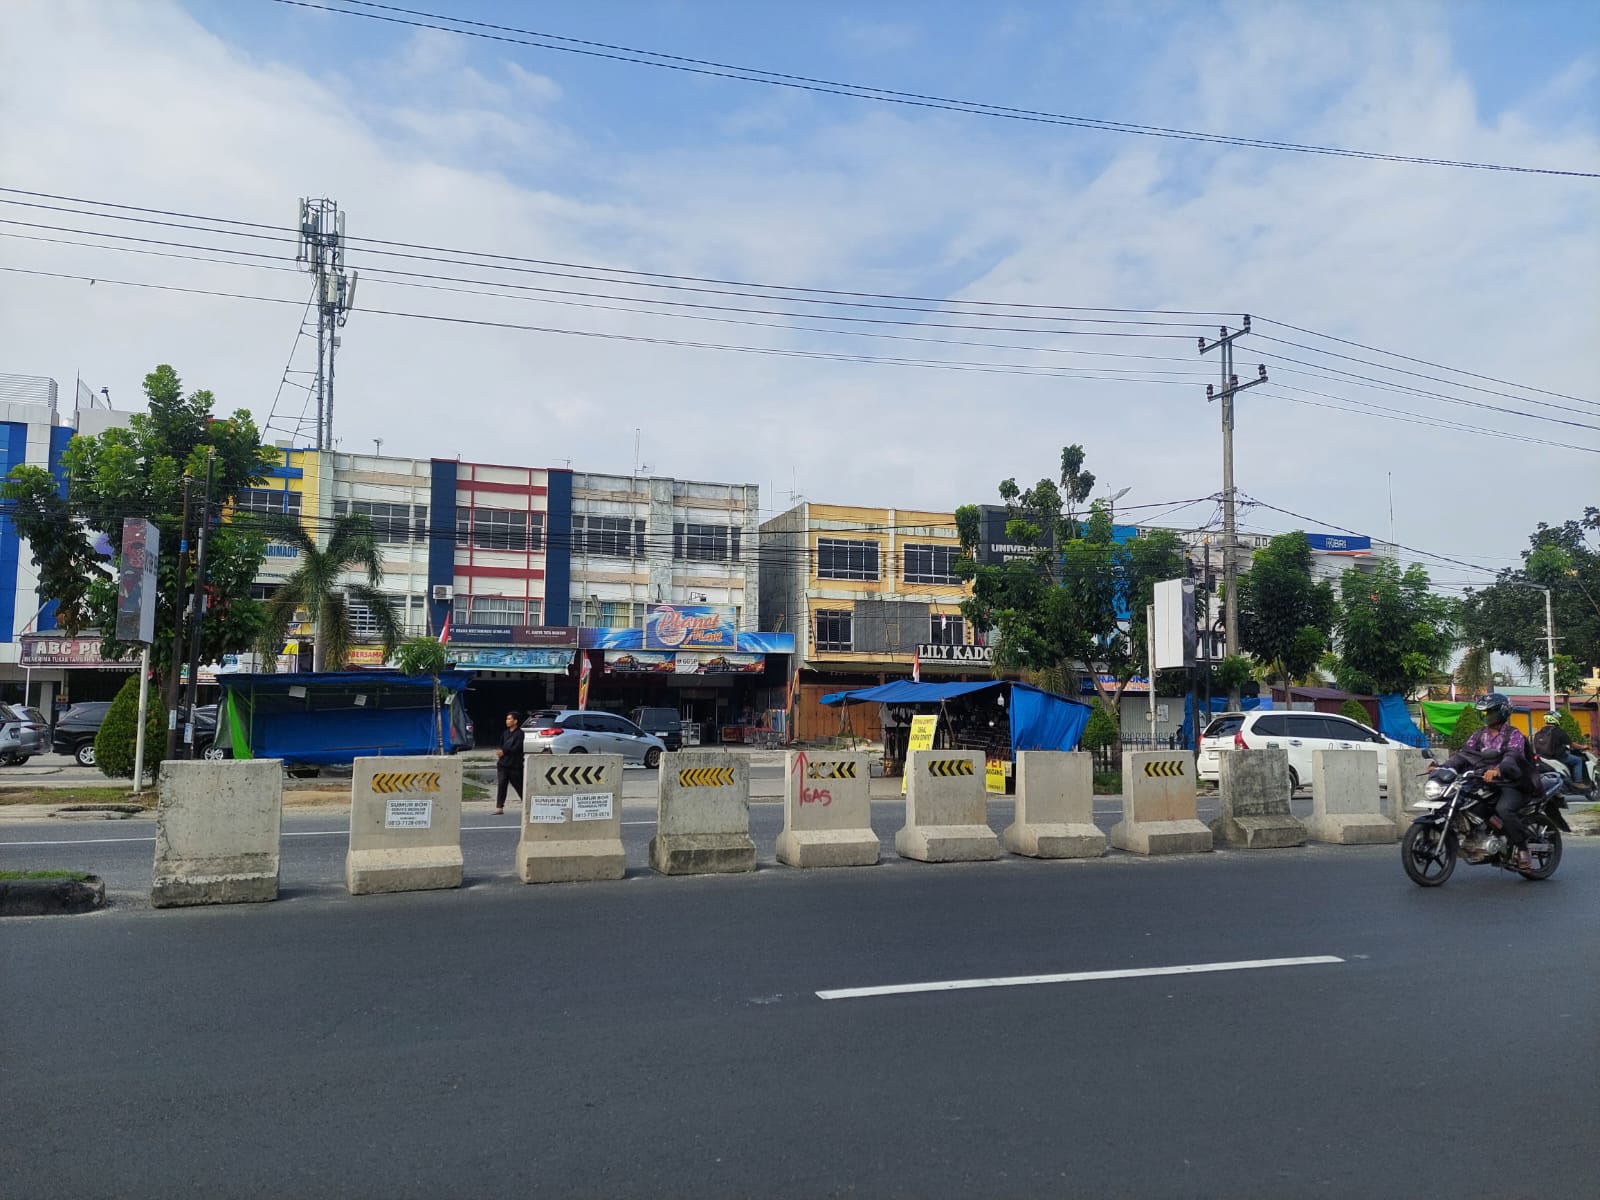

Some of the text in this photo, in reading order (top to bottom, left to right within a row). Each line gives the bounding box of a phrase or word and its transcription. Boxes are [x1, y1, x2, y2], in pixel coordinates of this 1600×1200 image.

[658, 610, 720, 633] Planet
[36, 641, 72, 655] ABC
[919, 645, 993, 660] LILY KADO
